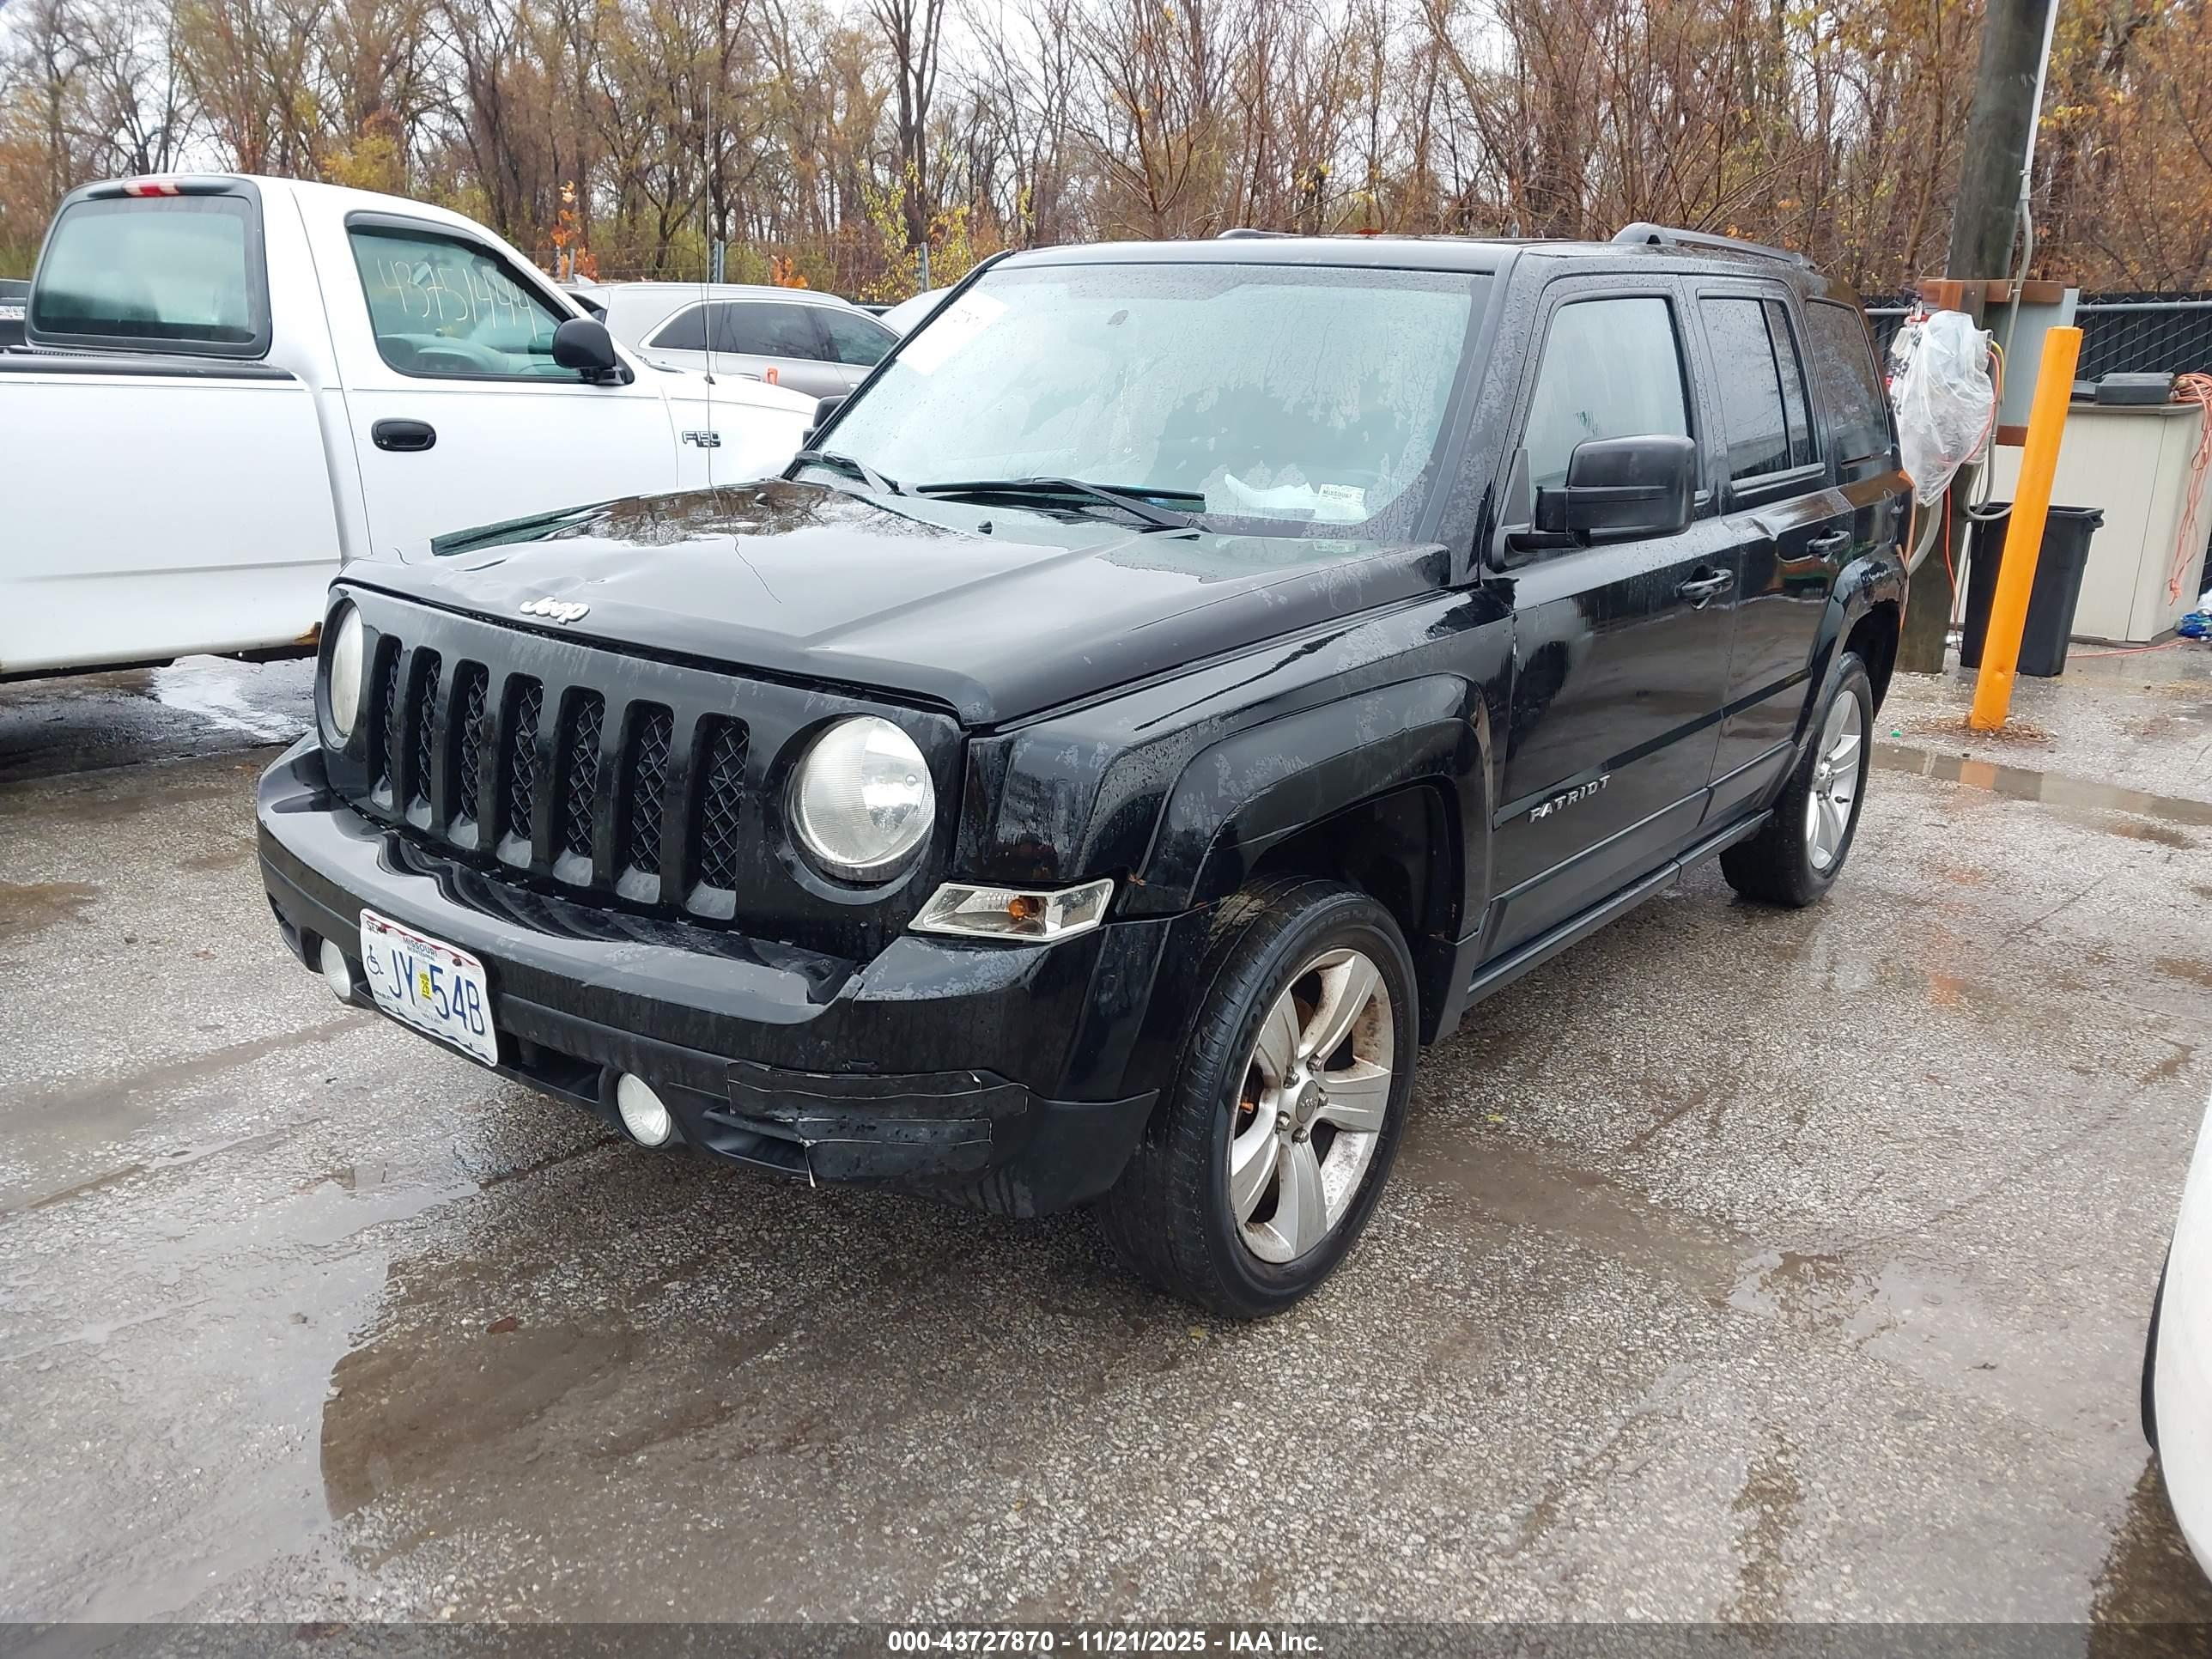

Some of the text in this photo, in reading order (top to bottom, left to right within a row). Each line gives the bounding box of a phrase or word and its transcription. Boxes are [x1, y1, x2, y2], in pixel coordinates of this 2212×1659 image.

[376, 256, 539, 343] 43751444
[519, 596, 591, 625] Jeep
[1528, 775, 1612, 823] PATRIOT
[403, 937, 438, 957] MISSOURI
[388, 948, 486, 1036] JY 54B
